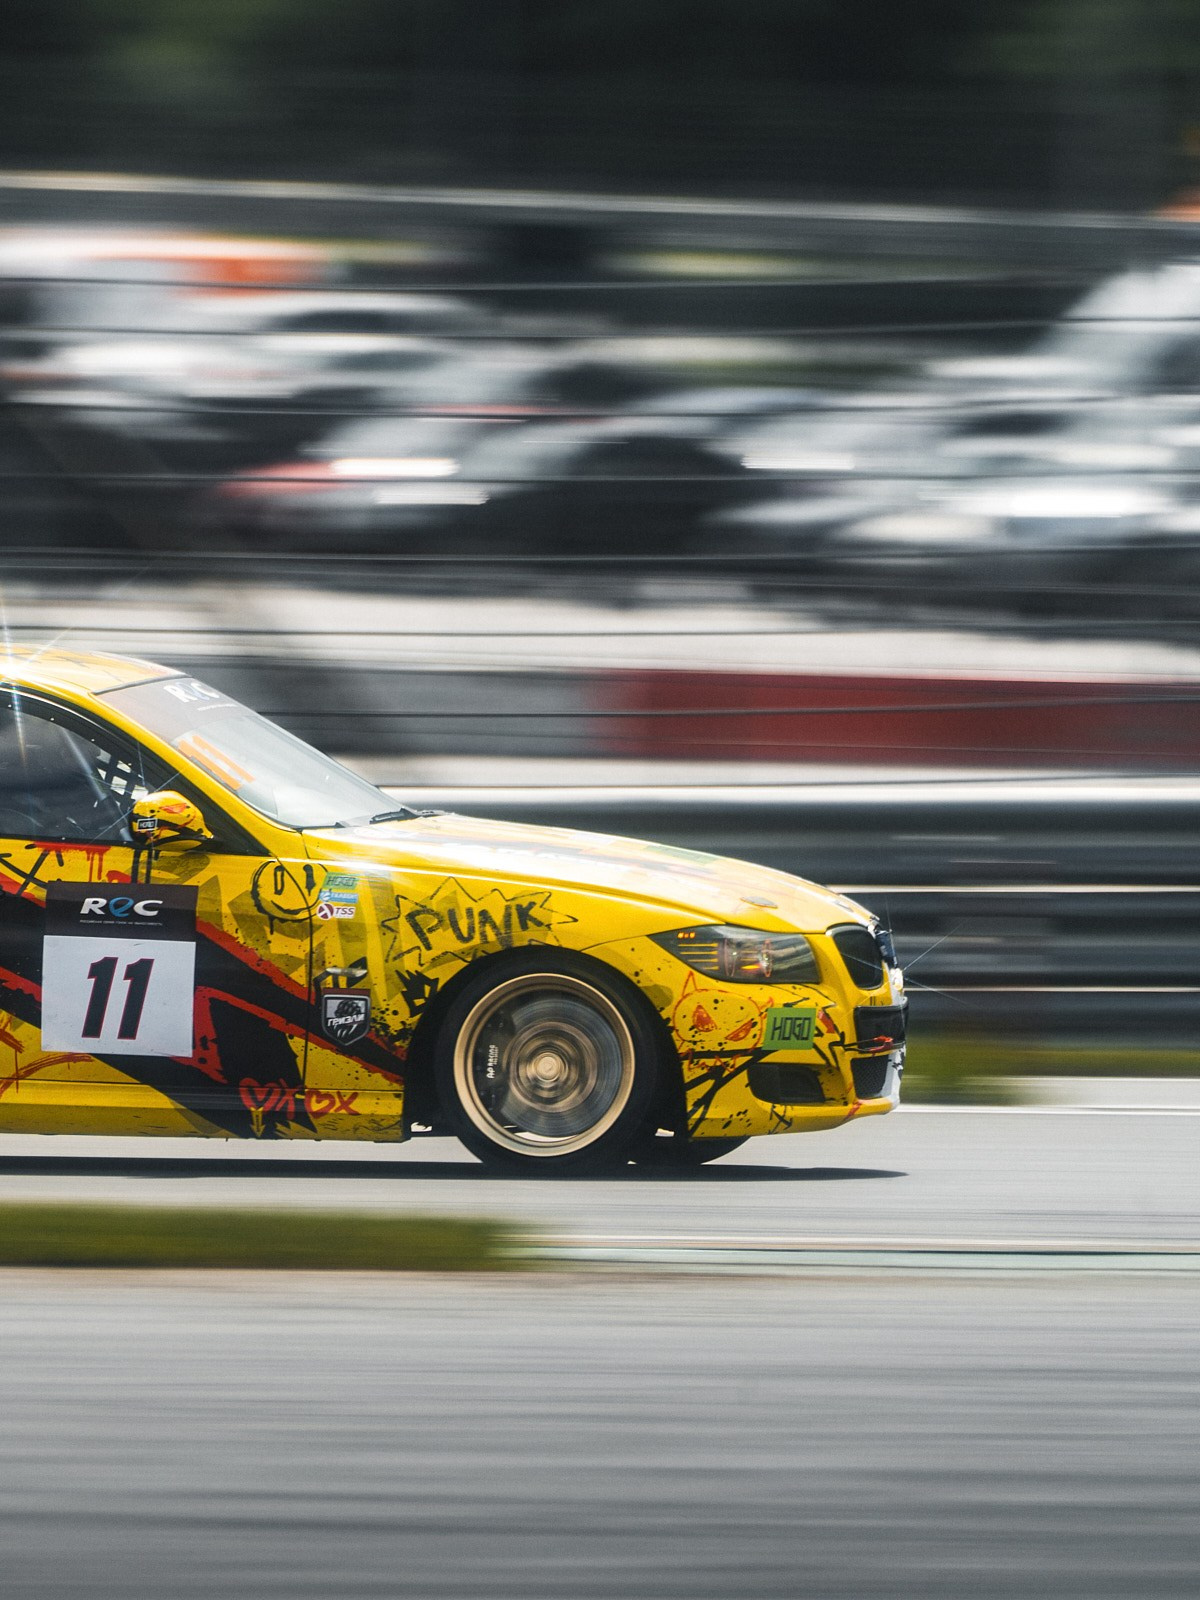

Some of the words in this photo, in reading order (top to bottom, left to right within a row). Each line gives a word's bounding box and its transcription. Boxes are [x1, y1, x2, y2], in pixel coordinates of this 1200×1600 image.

[178, 735, 256, 790] 11
[335, 907, 355, 916] TSS
[405, 901, 544, 950] PUNK
[81, 956, 155, 1040] 11
[328, 1014, 365, 1027] ГРИЗЛИ
